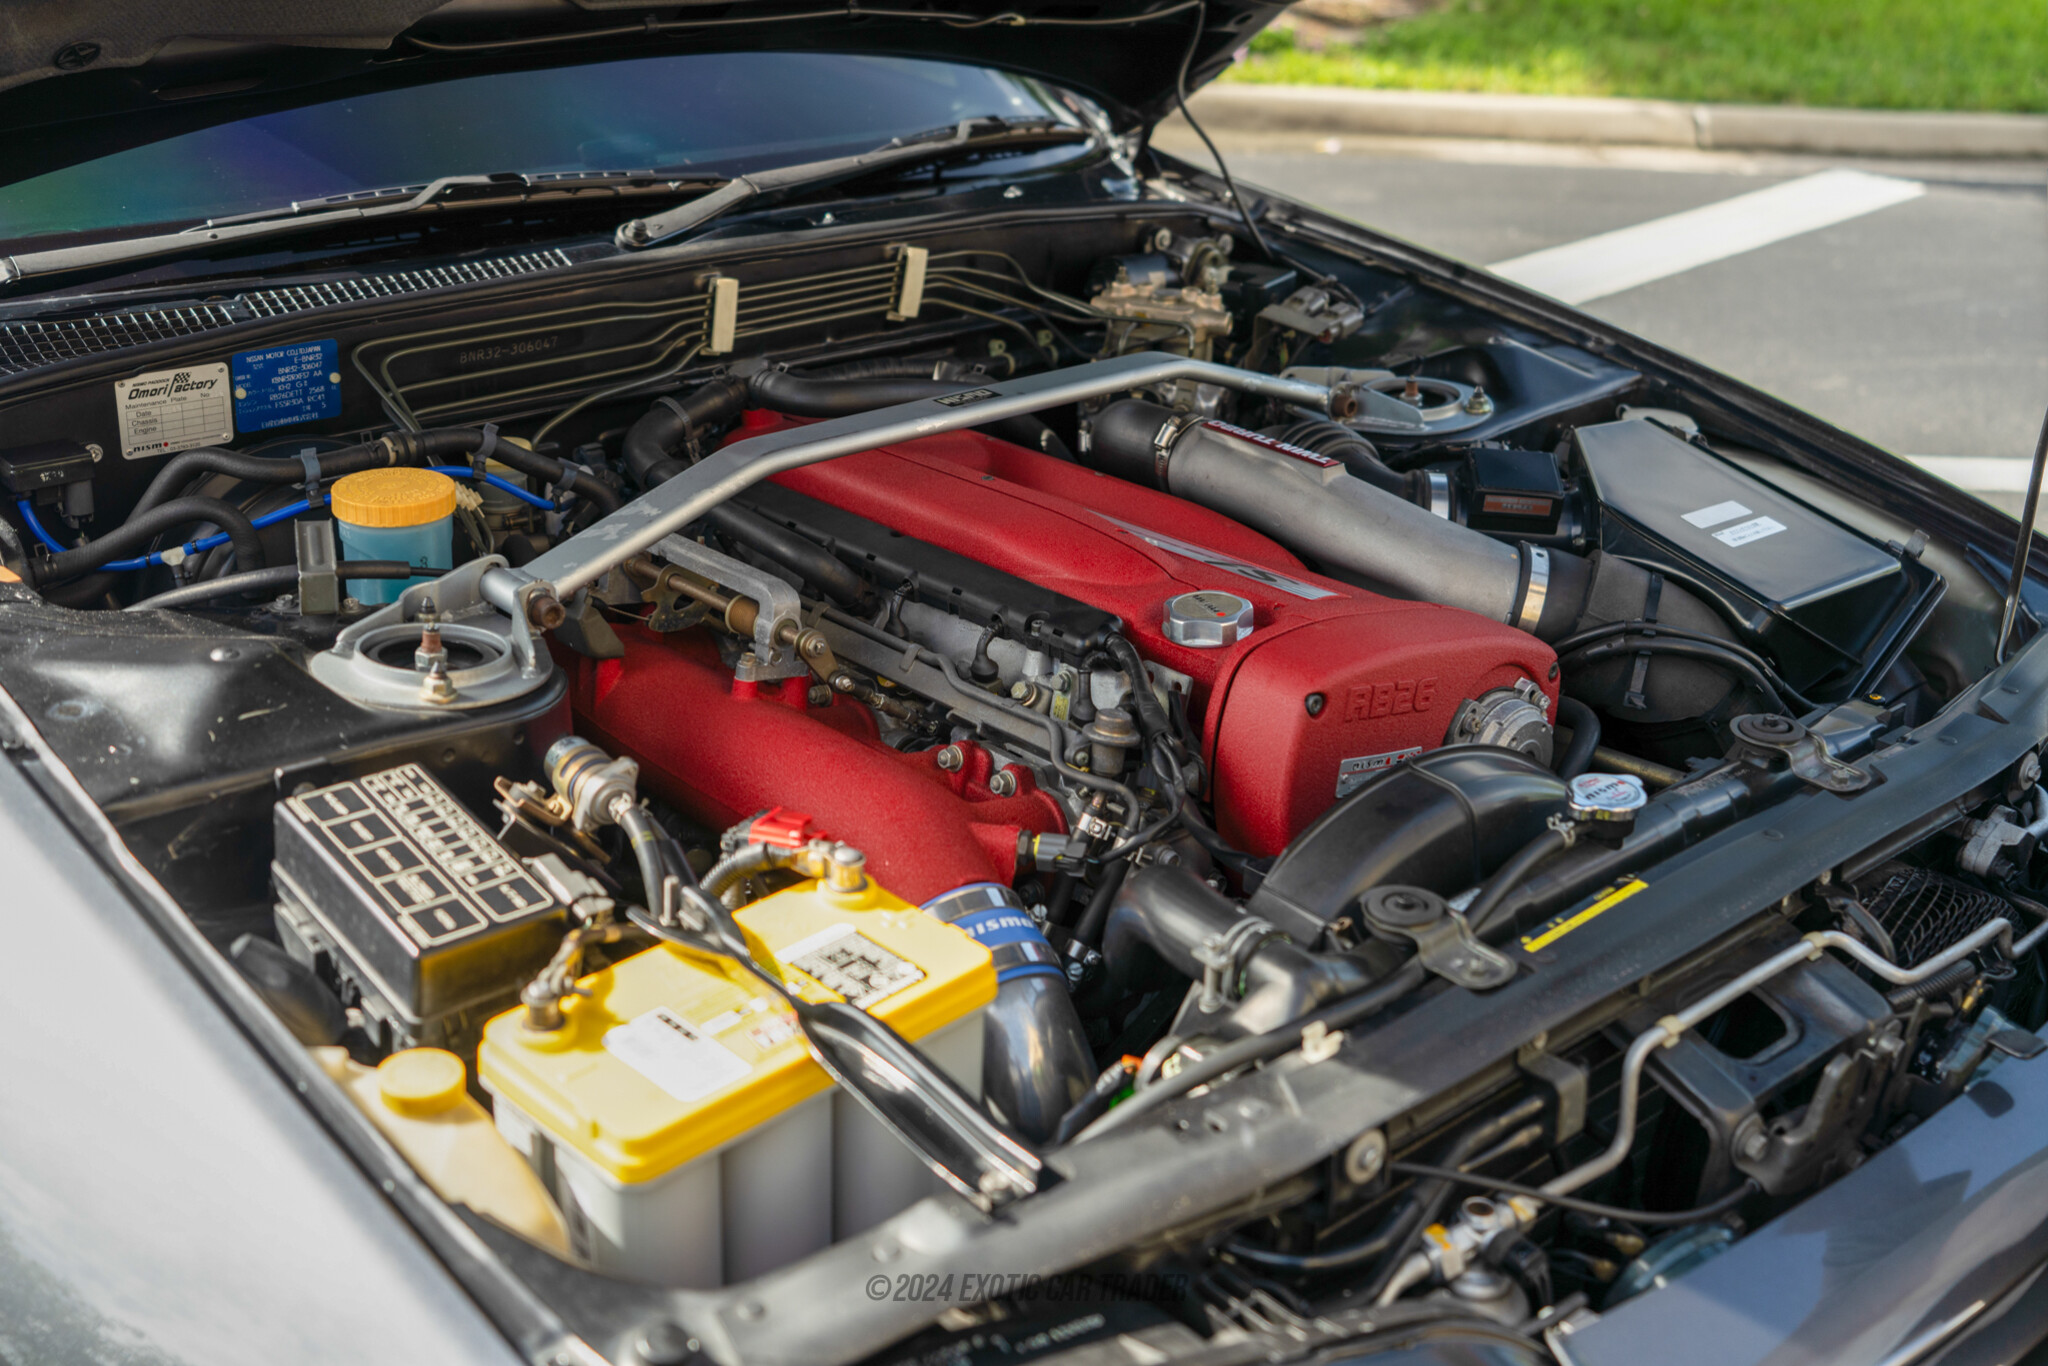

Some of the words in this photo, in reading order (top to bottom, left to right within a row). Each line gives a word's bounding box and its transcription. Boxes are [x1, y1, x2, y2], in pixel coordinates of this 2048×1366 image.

[246, 354, 264, 363] NISSAN
[266, 350, 284, 360] MOTOR
[460, 336, 558, 364] BNR32-306047
[294, 353, 323, 363] E-BNR32
[278, 361, 323, 374] BNR32-306047
[128, 384, 169, 400] Omori
[270, 389, 303, 401] RB26DETT
[126, 399, 167, 410] Maintenance
[136, 410, 152, 418] Date
[132, 418, 158, 427] Chassis
[134, 426, 157, 435] Engine
[1208, 420, 1276, 444] TURBO
[1275, 442, 1330, 464] TWIN
[1344, 677, 1438, 722] RB26
